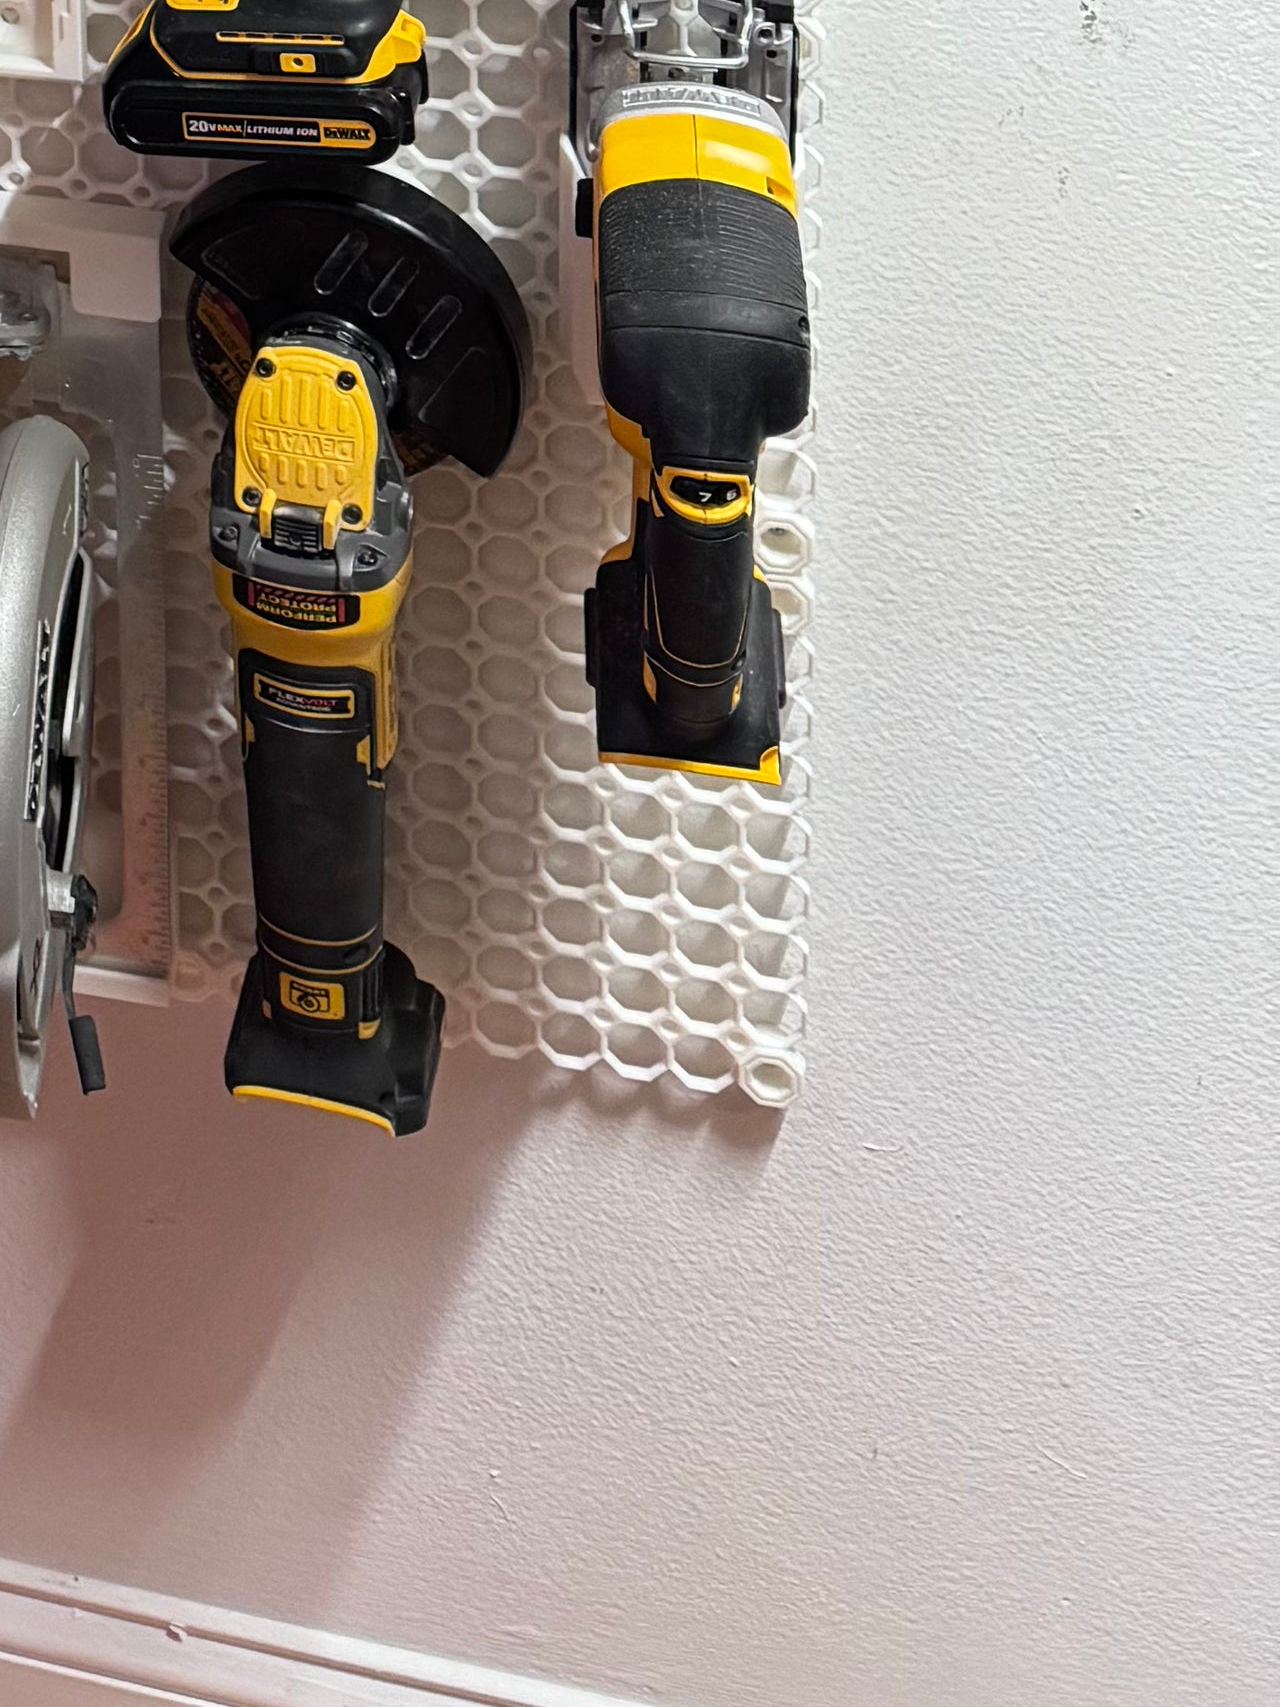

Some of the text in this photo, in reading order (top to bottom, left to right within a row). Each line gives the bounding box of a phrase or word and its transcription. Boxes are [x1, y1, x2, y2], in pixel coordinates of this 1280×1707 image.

[247, 125, 294, 135] LITHIUM
[297, 128, 318, 137] ION
[255, 427, 354, 460] DEWALT
[699, 492, 712, 502] 7
[256, 602, 337, 623] PERFORM
[259, 592, 337, 613] PROTECT
